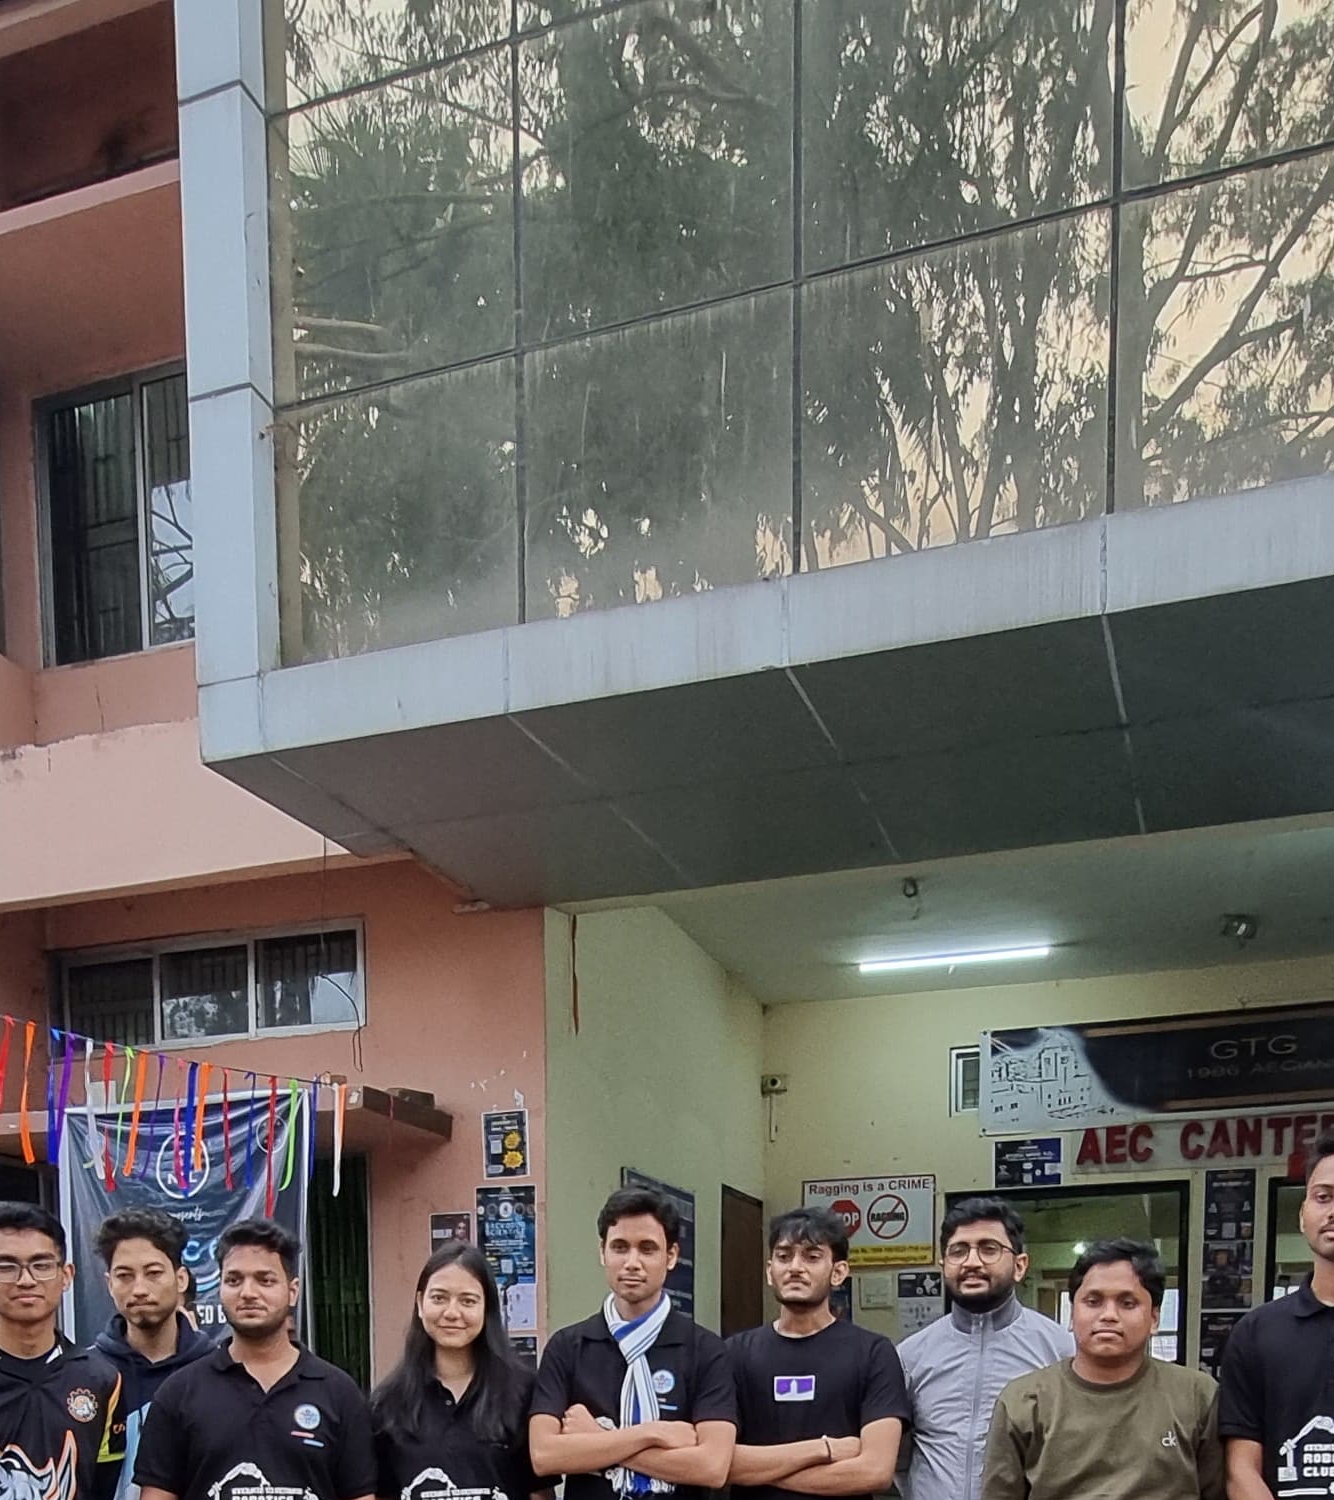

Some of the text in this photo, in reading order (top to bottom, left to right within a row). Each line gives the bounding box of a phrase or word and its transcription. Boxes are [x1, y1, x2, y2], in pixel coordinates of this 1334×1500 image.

[1210, 1034, 1298, 1060] GTG
[1076, 1124, 1154, 1165] AEC
[809, 1184, 859, 1196] Ragging
[863, 1182, 870, 1191] is
[888, 1179, 930, 1190] CRIME
